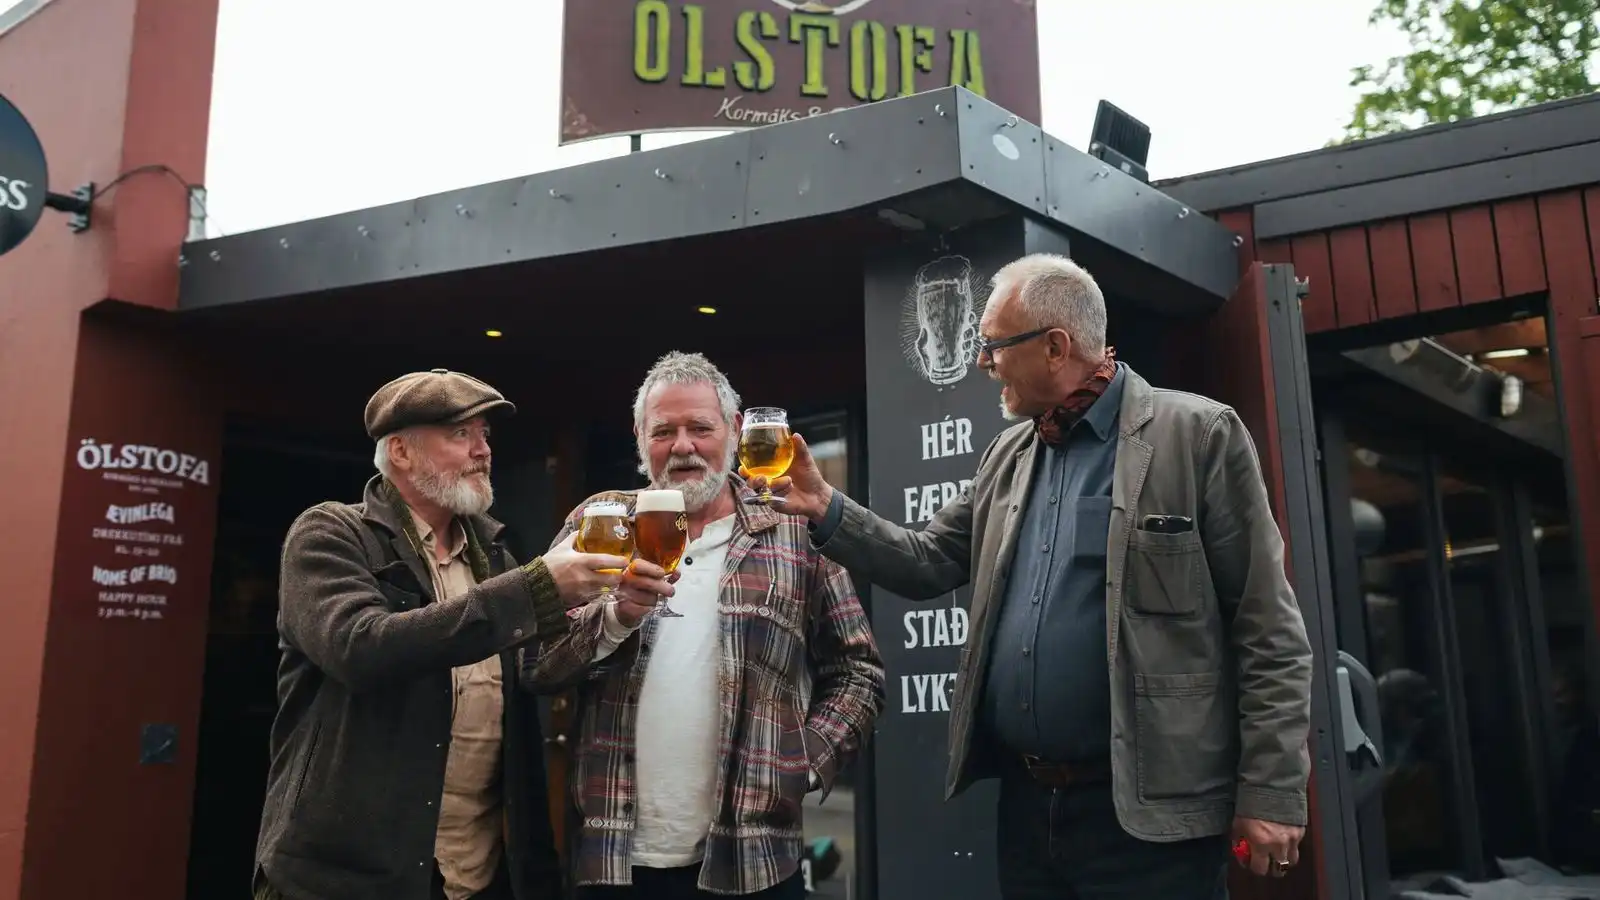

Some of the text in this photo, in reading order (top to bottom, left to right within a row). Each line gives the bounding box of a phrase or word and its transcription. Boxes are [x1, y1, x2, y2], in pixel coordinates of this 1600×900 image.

[920, 414, 974, 461] HÉR
[76, 438, 210, 485] ÖLSTOFA
[92, 565, 128, 586] HOME
[130, 566, 147, 584] OF
[903, 607, 969, 649] STAÐ
